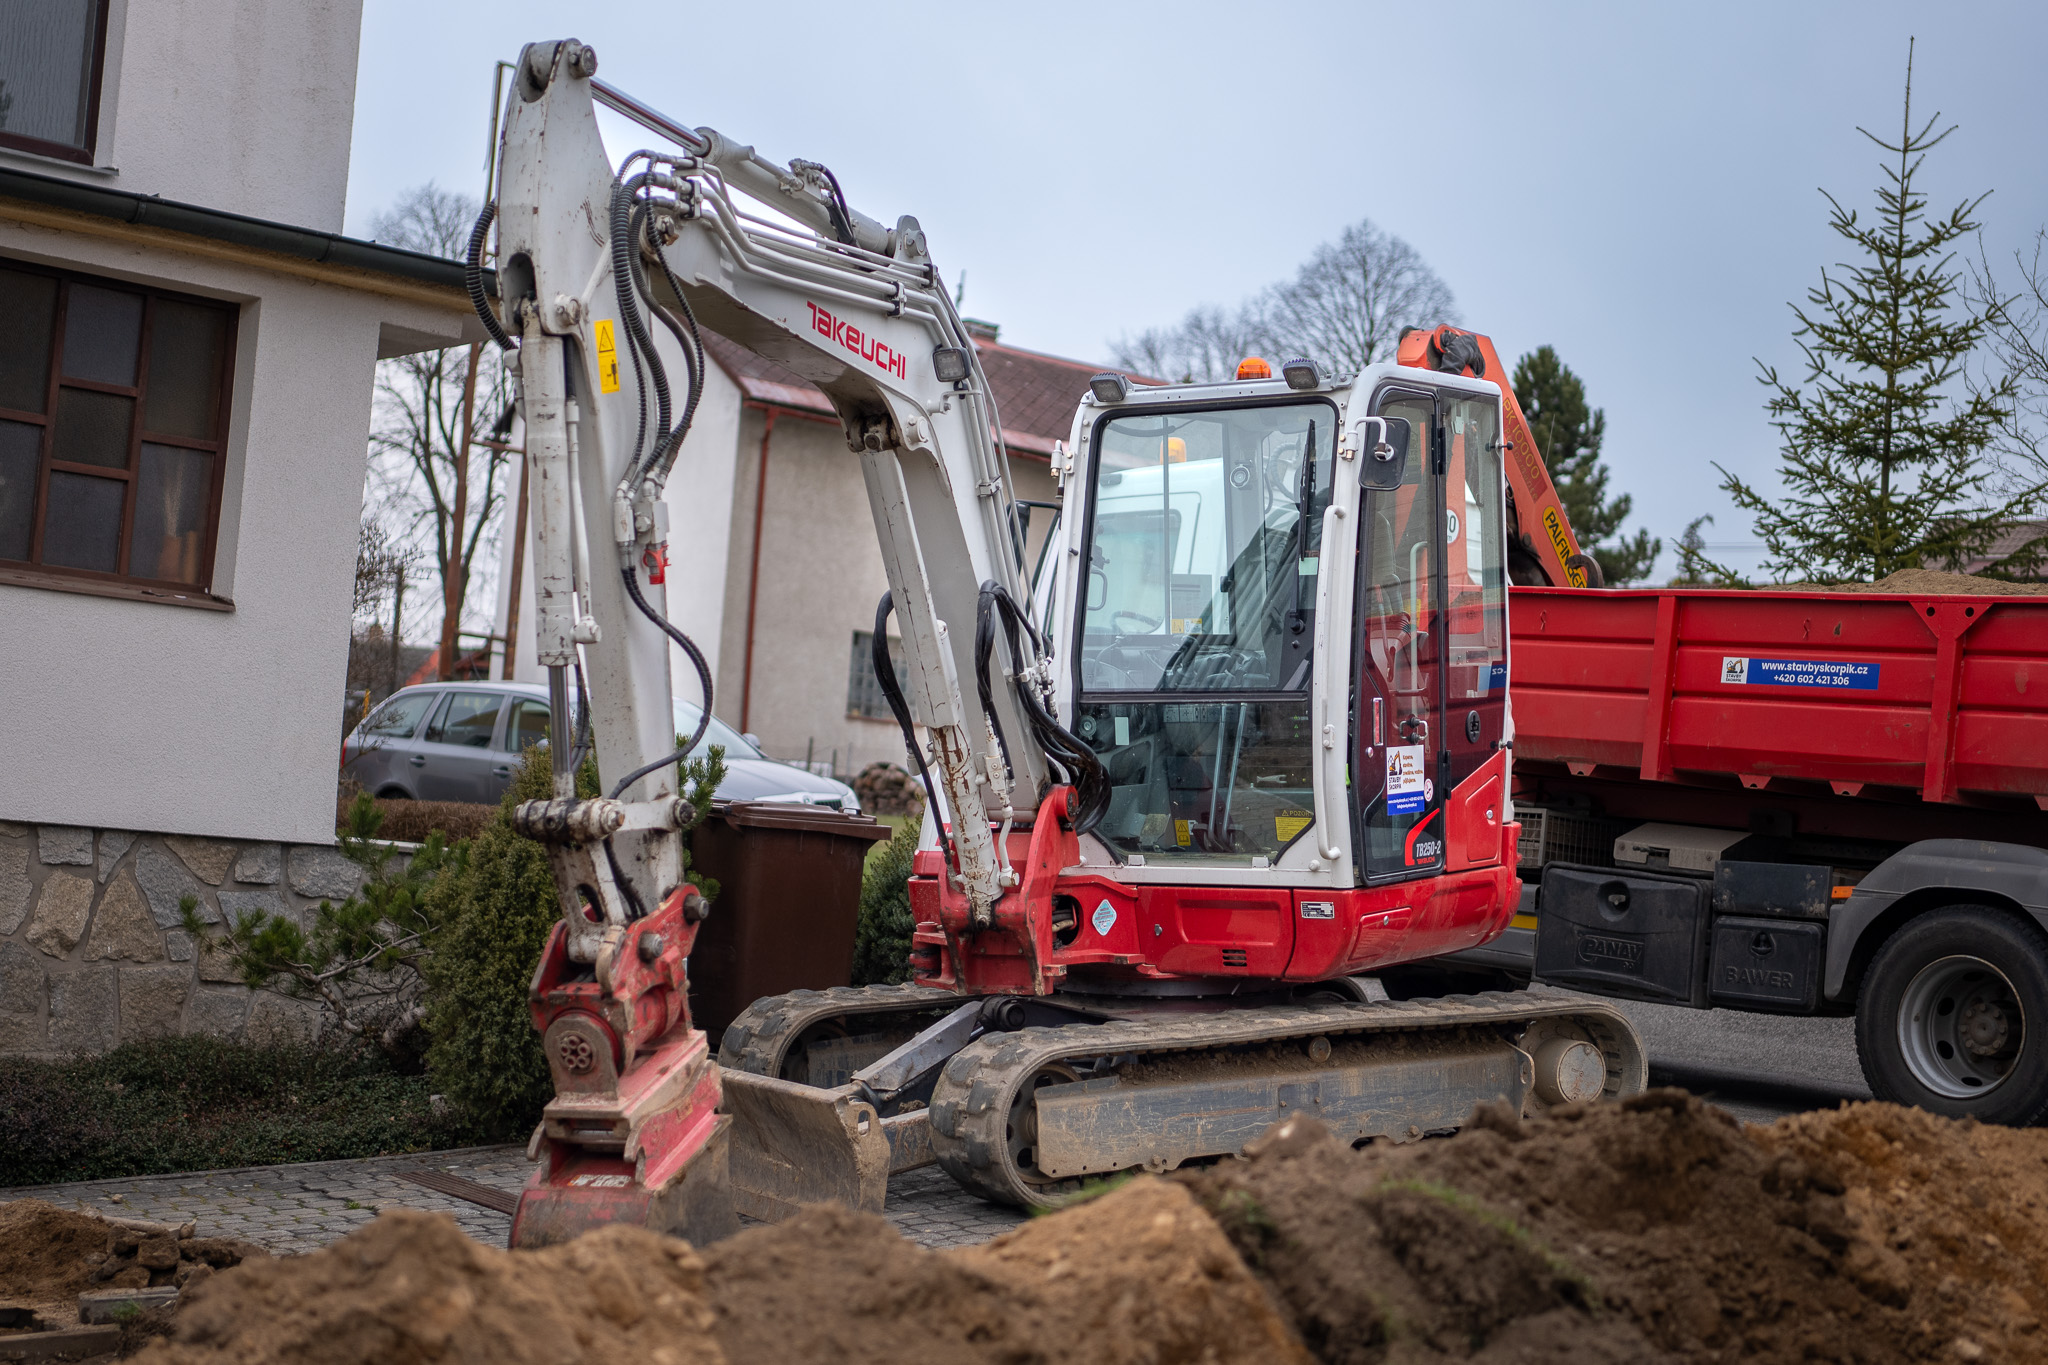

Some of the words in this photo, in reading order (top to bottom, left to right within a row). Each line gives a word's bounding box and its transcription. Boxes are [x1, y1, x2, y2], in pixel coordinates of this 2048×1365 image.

[1512, 424, 1540, 480] 10000
[1761, 662, 1869, 676] www.stavbyskorpik.cz
[1773, 674, 1796, 683] +420
[1797, 675, 1814, 684] 602
[1815, 675, 1830, 685] 421
[1832, 676, 1850, 685] 306
[1416, 840, 1442, 858] TB250-2
[1726, 965, 1793, 989] BAWER
